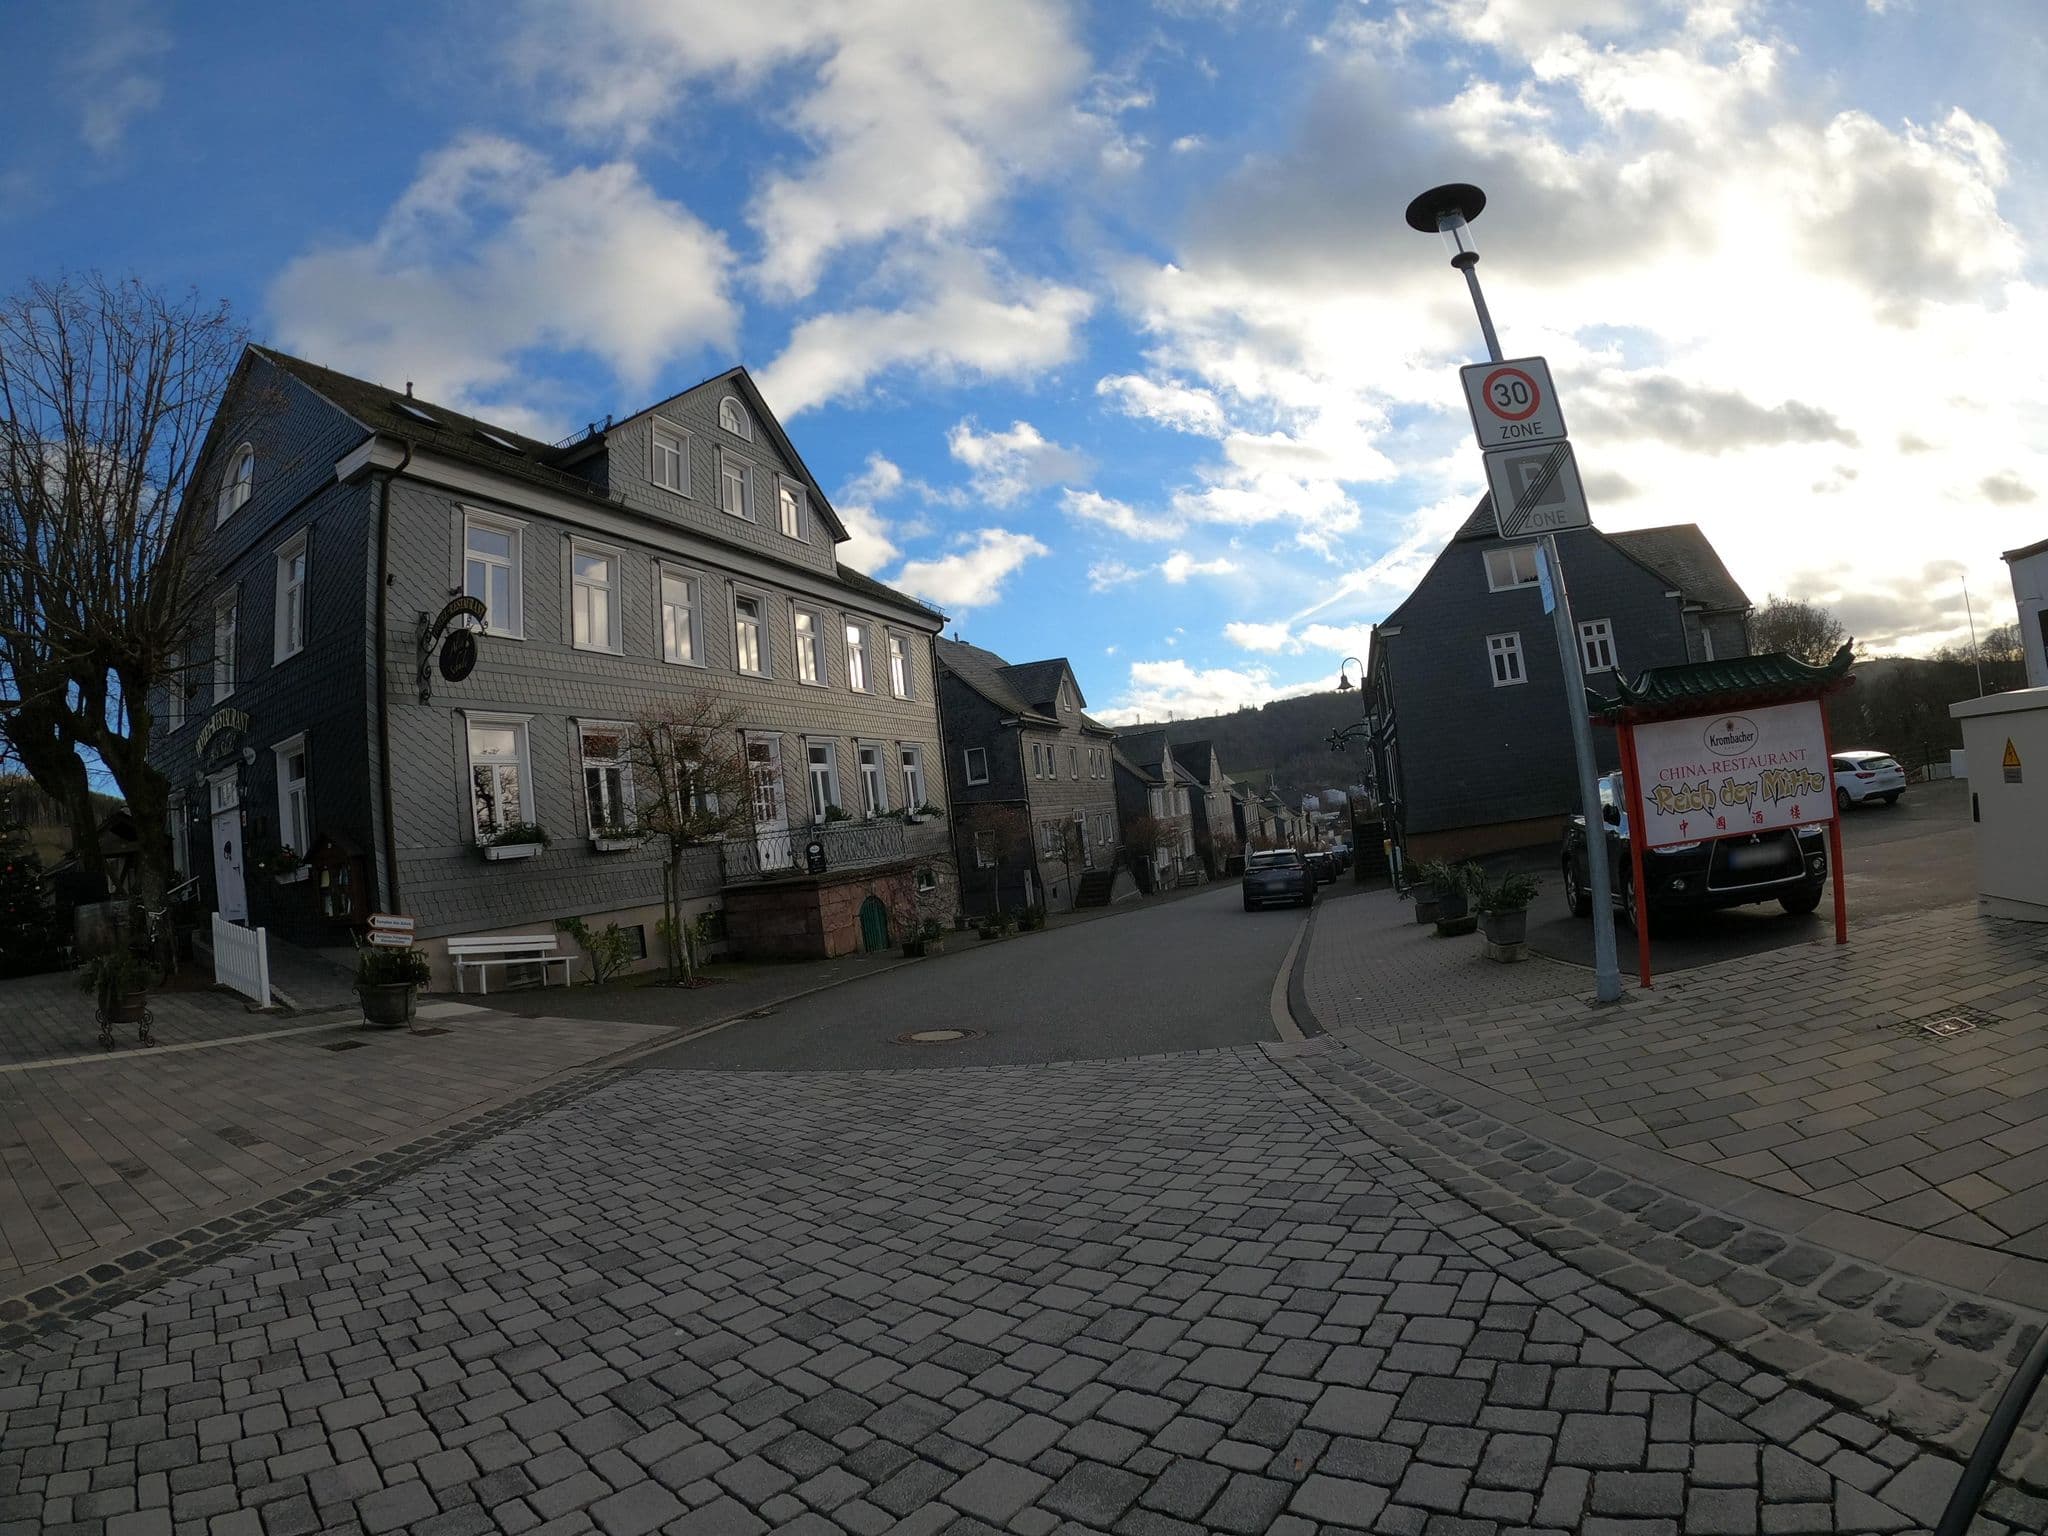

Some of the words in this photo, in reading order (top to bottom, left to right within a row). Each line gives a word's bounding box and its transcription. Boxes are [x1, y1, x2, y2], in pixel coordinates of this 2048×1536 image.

[1494, 381, 1529, 407] 30
[1500, 422, 1544, 440] ZONE
[1524, 510, 1568, 529] ZONE
[1709, 731, 1755, 747] Krombacher
[1659, 749, 1807, 782] CHINA-RESTAURANT
[1646, 780, 1717, 818] Reich
[1720, 777, 1758, 813] der
[1759, 768, 1826, 807] Mitte
